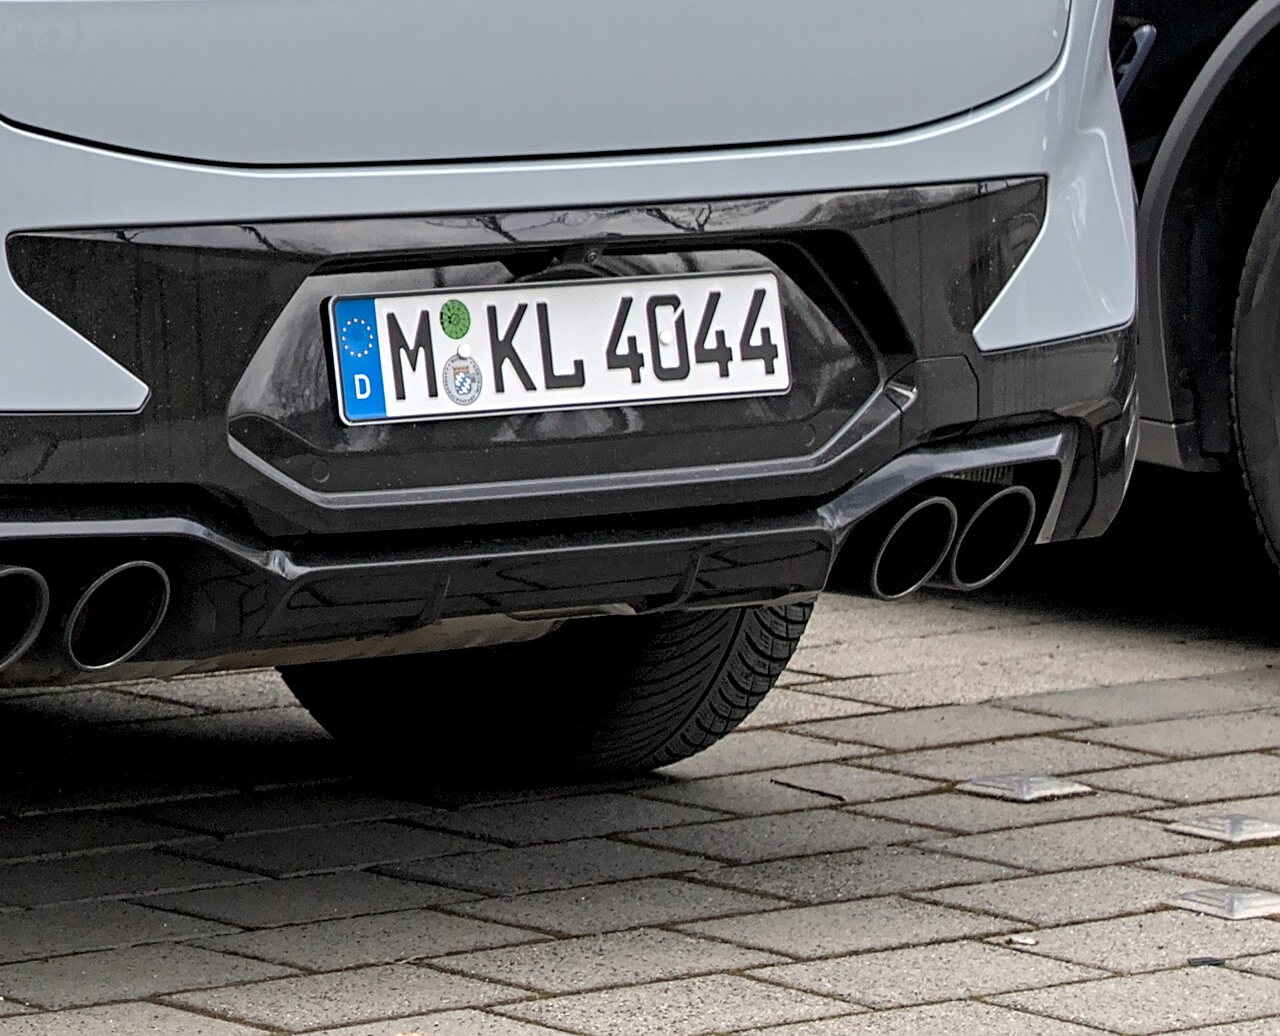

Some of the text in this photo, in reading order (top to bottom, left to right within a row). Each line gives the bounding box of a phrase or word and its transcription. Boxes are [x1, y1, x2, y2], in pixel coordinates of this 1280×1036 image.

[386, 309, 439, 401] M
[486, 301, 587, 394] KL
[604, 287, 780, 385] 4044
[353, 374, 371, 400] D
